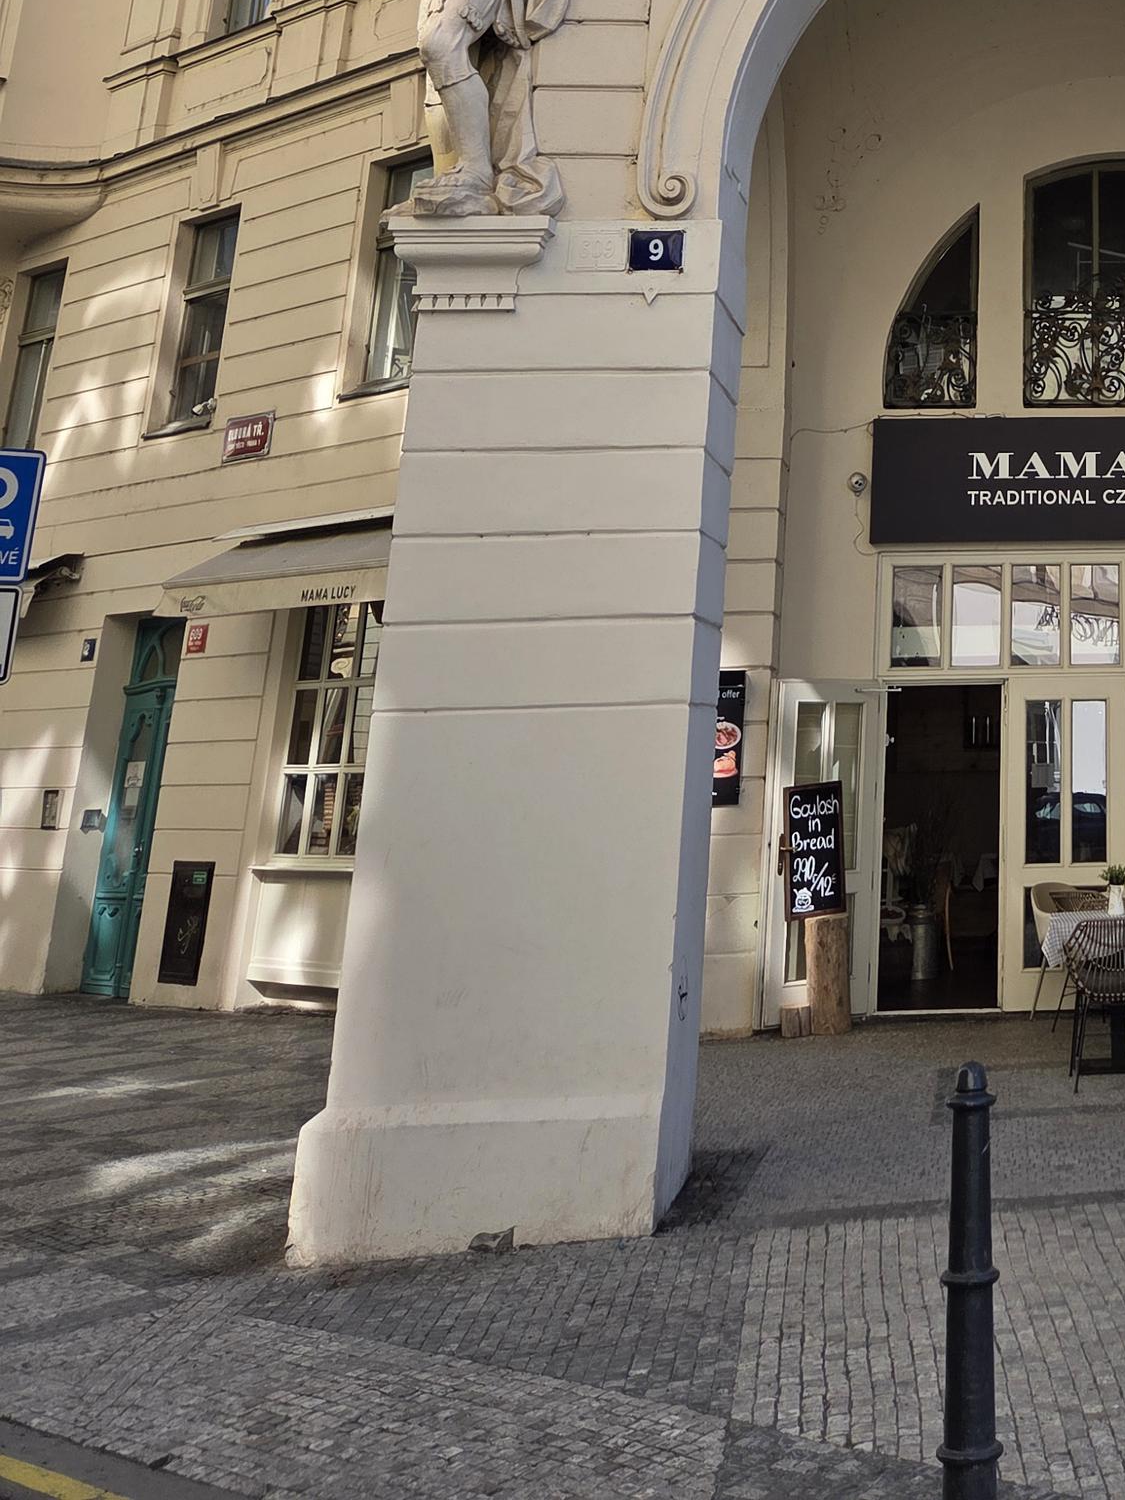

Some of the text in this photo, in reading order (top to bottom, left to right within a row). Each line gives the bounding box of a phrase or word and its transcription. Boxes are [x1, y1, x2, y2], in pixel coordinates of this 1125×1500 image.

[648, 238, 664, 261] 9
[967, 489, 1096, 506] TRADITIONAL
[301, 585, 356, 602] MAMA LUCY
[721, 689, 741, 699] offer
[789, 794, 840, 819] Goulash
[808, 815, 822, 833] in
[791, 827, 835, 854] Bread
